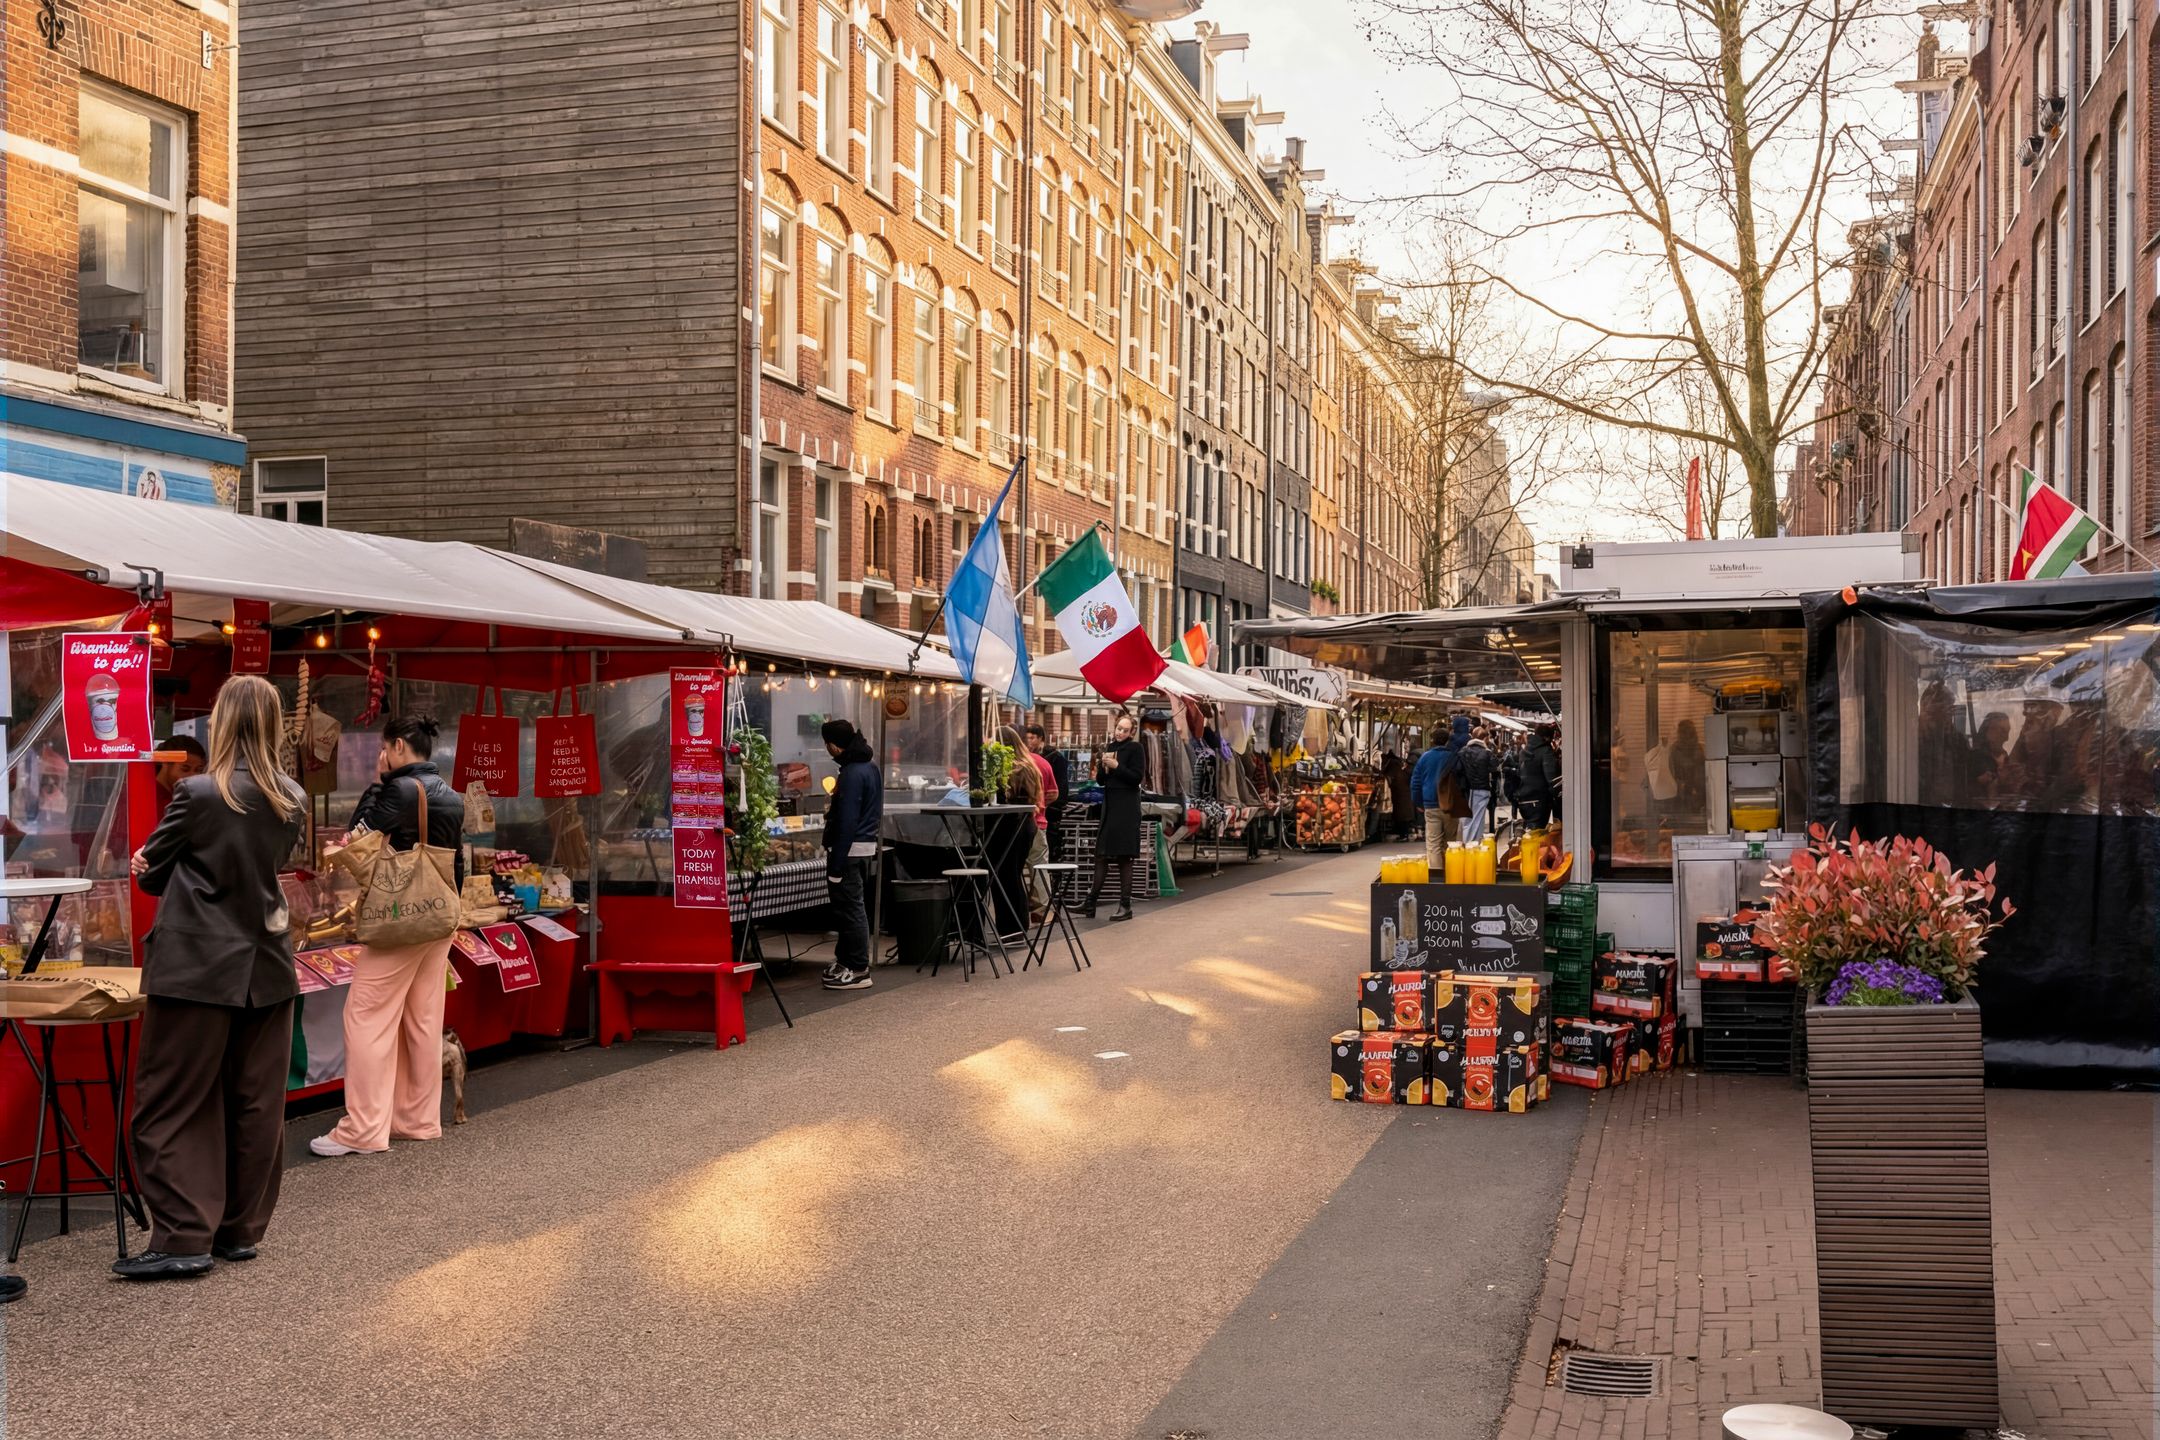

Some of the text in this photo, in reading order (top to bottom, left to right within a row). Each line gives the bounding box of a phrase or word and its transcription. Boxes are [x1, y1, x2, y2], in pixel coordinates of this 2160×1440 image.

[93, 653, 144, 673] to go!!
[558, 756, 580, 766] FRESH
[682, 848, 716, 859] TODAY
[683, 861, 713, 872] FRESH
[1424, 905, 1464, 918] 200 ml
[1451, 920, 1464, 933] ml
[1451, 937, 1464, 948] ml
